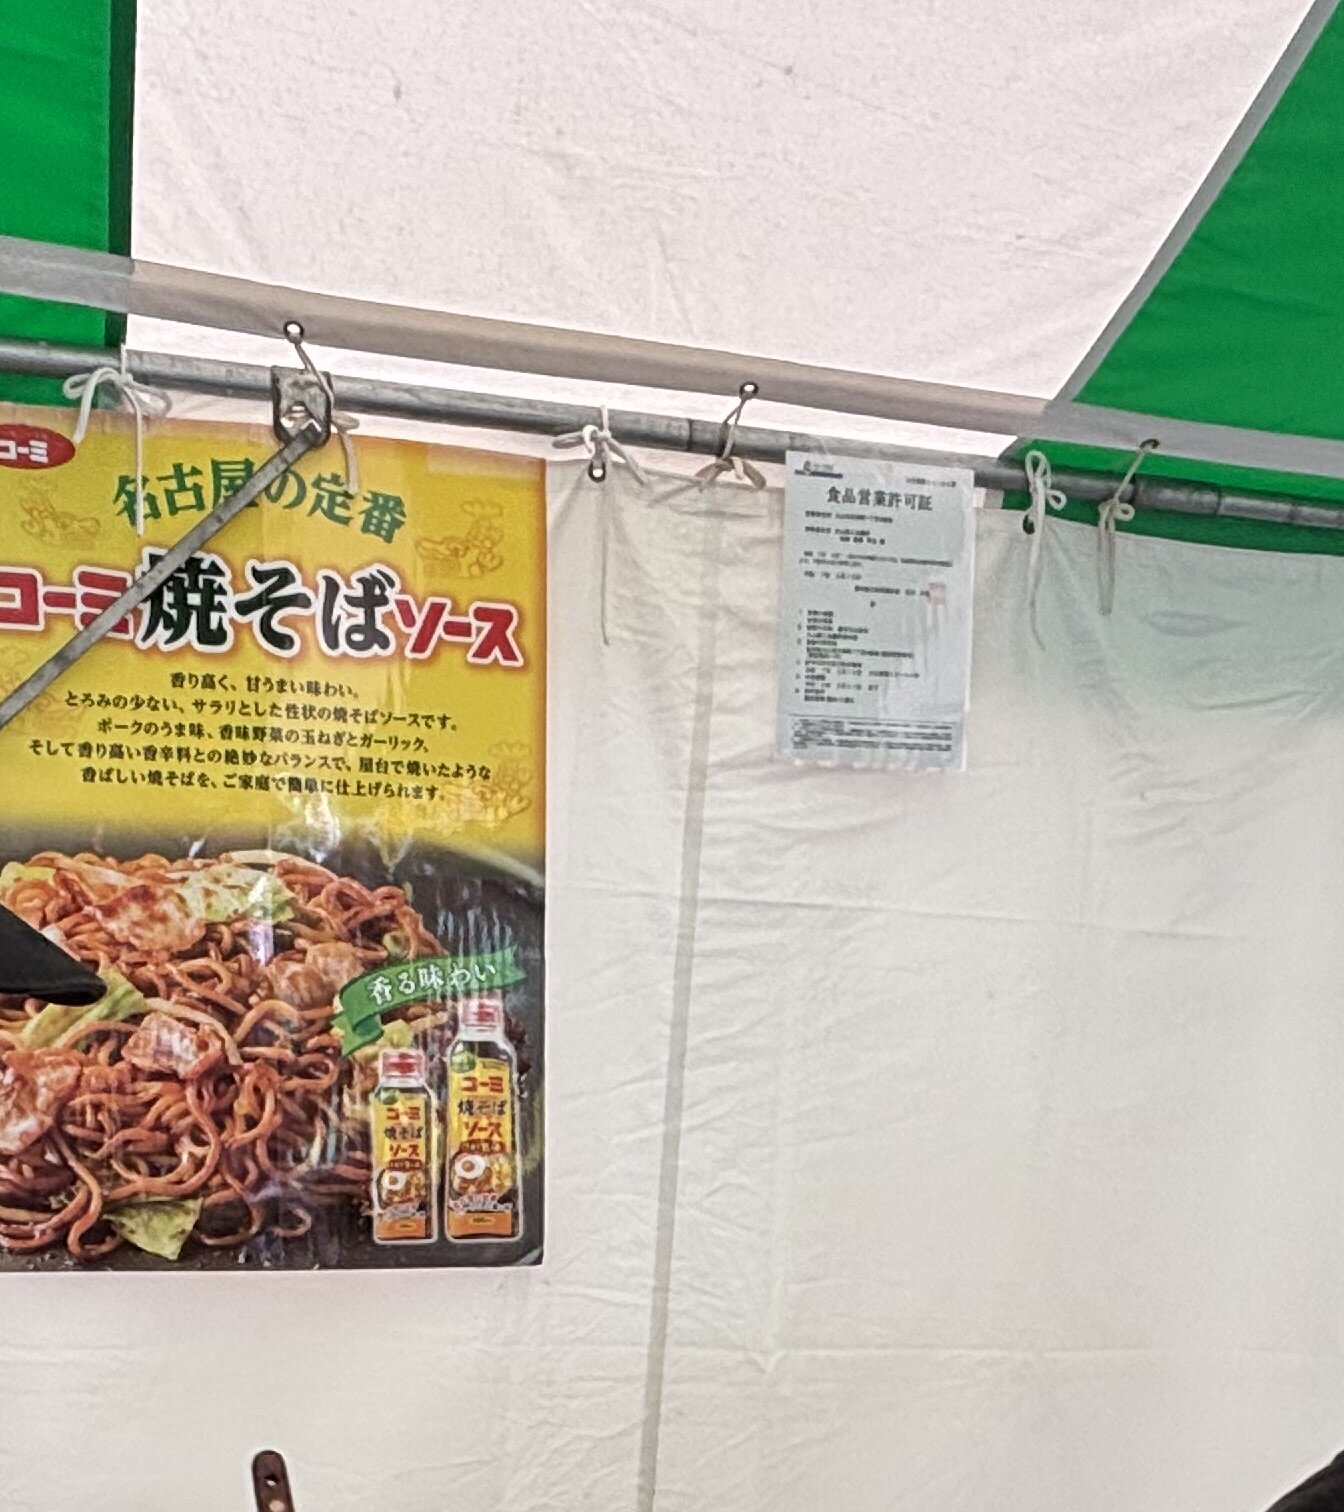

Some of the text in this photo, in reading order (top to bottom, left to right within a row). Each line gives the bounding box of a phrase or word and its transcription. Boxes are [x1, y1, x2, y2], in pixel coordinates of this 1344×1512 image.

[113, 457, 407, 544] 名古屋の定番
[827, 486, 933, 511] 食品営業許可証
[369, 963, 496, 1005] 香る味わい
[462, 1076, 504, 1094] コーミ
[458, 1099, 507, 1117] 焼そば
[465, 1120, 503, 1139] ソース
